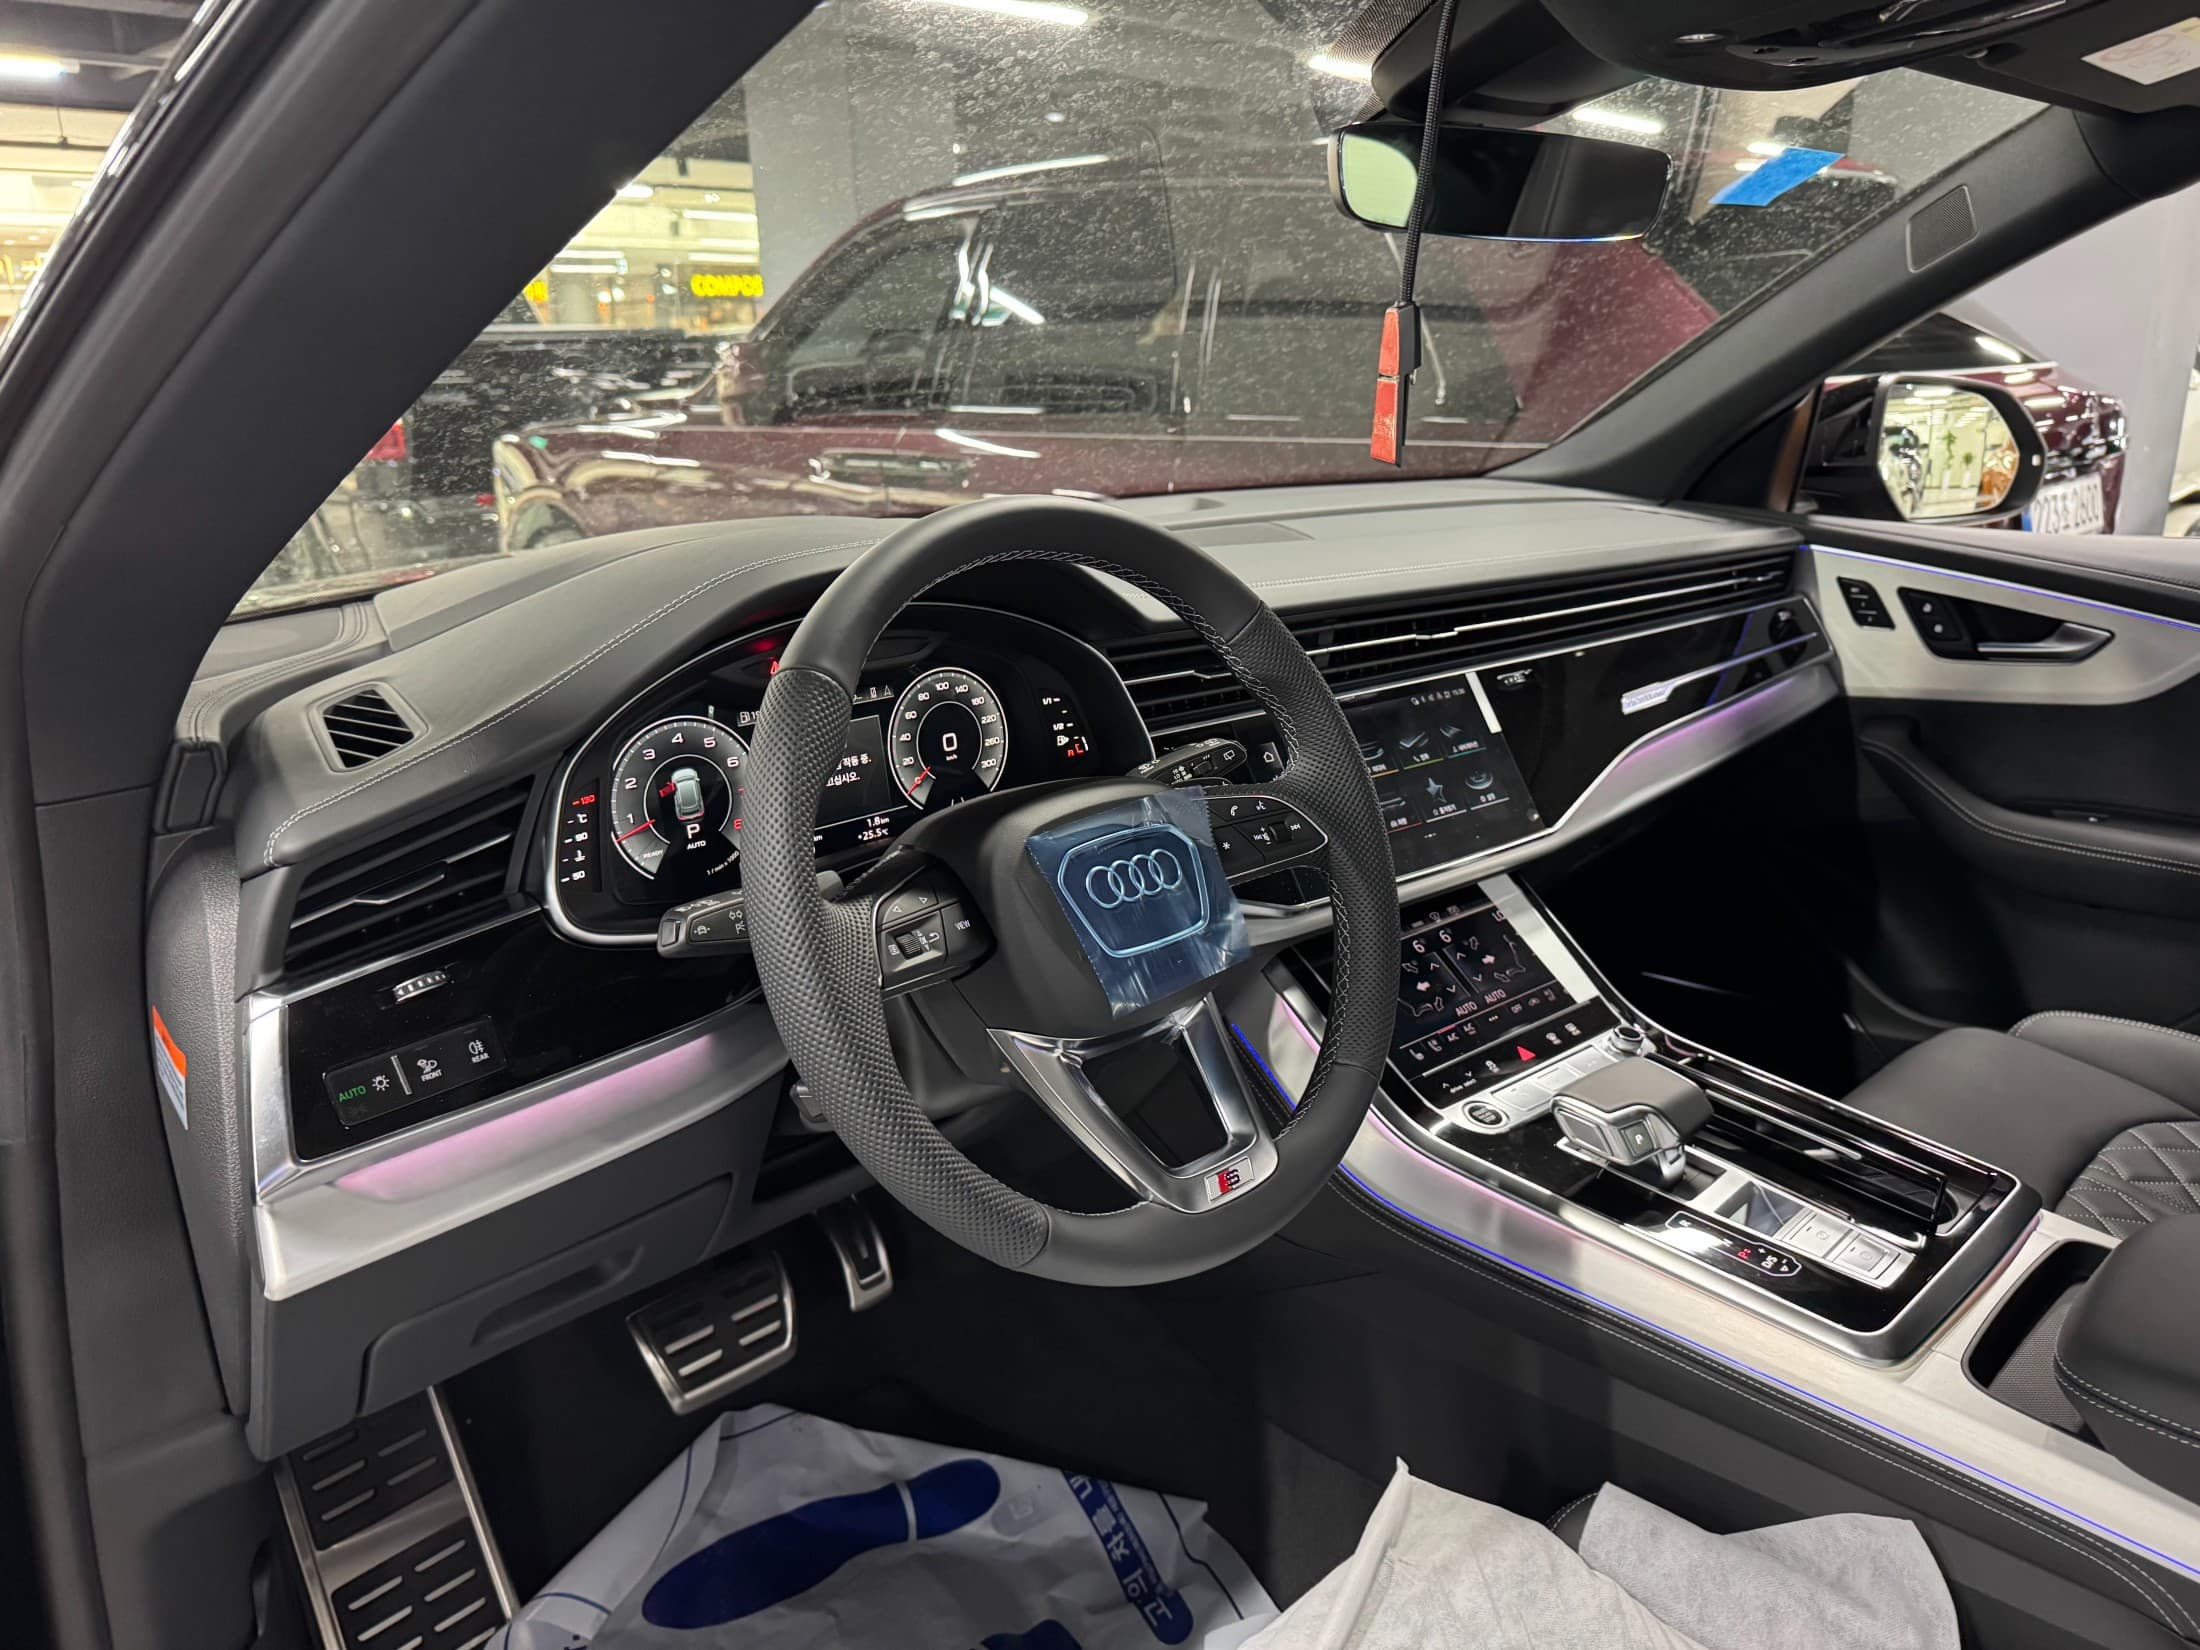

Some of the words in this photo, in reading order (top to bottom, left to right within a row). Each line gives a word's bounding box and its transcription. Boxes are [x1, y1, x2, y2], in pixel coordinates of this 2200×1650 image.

[936, 682, 949, 690] 100
[955, 685, 968, 693] 140
[905, 711, 917, 719] 60
[981, 714, 996, 723] 220
[671, 733, 683, 743] 4
[900, 733, 911, 741] 40
[942, 733, 957, 751] 0
[704, 738, 715, 747] 5
[643, 749, 655, 760] 3
[727, 757, 738, 767] 6
[903, 757, 914, 766] 20
[981, 759, 996, 768] 300
[625, 778, 637, 789] 2
[627, 813, 634, 823] 1
[687, 824, 701, 839] P
[687, 840, 706, 850] AUTO
[1484, 989, 1507, 1005] AUTO
[1455, 1001, 1478, 1018] AUTO
[338, 1085, 367, 1103] AUTO
[1635, 1133, 1643, 1145] P
